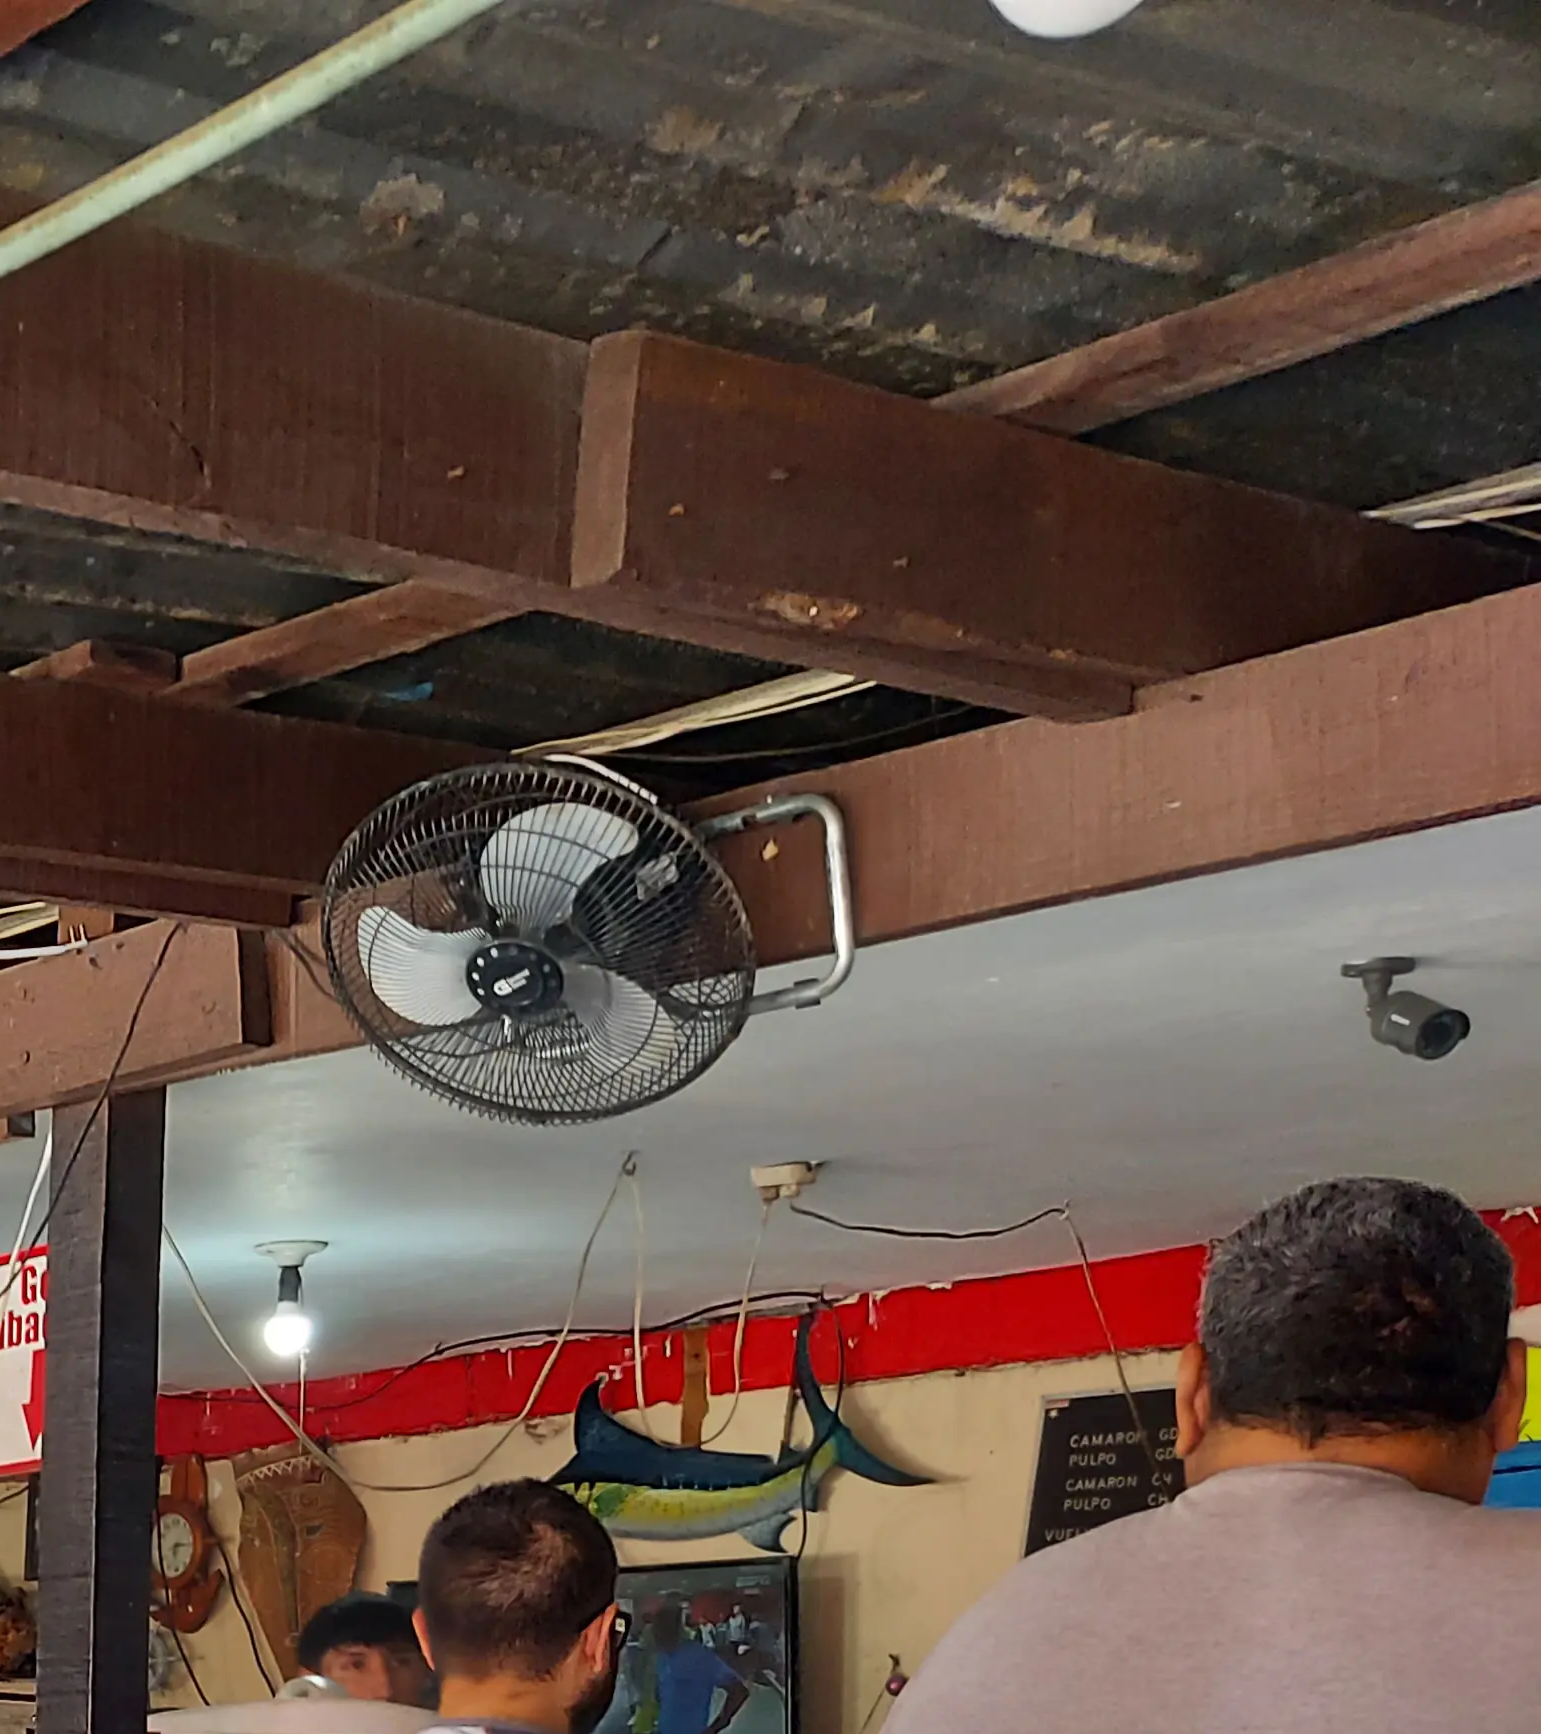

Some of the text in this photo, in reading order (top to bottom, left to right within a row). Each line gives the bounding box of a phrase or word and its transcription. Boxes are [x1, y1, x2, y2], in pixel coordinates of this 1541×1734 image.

[1158, 1427, 1177, 1441] GD
[1068, 1447, 1175, 1467] PULPO GD
[1064, 1476, 1138, 1492] CAMARON
[1063, 1498, 1111, 1512] PULPO
